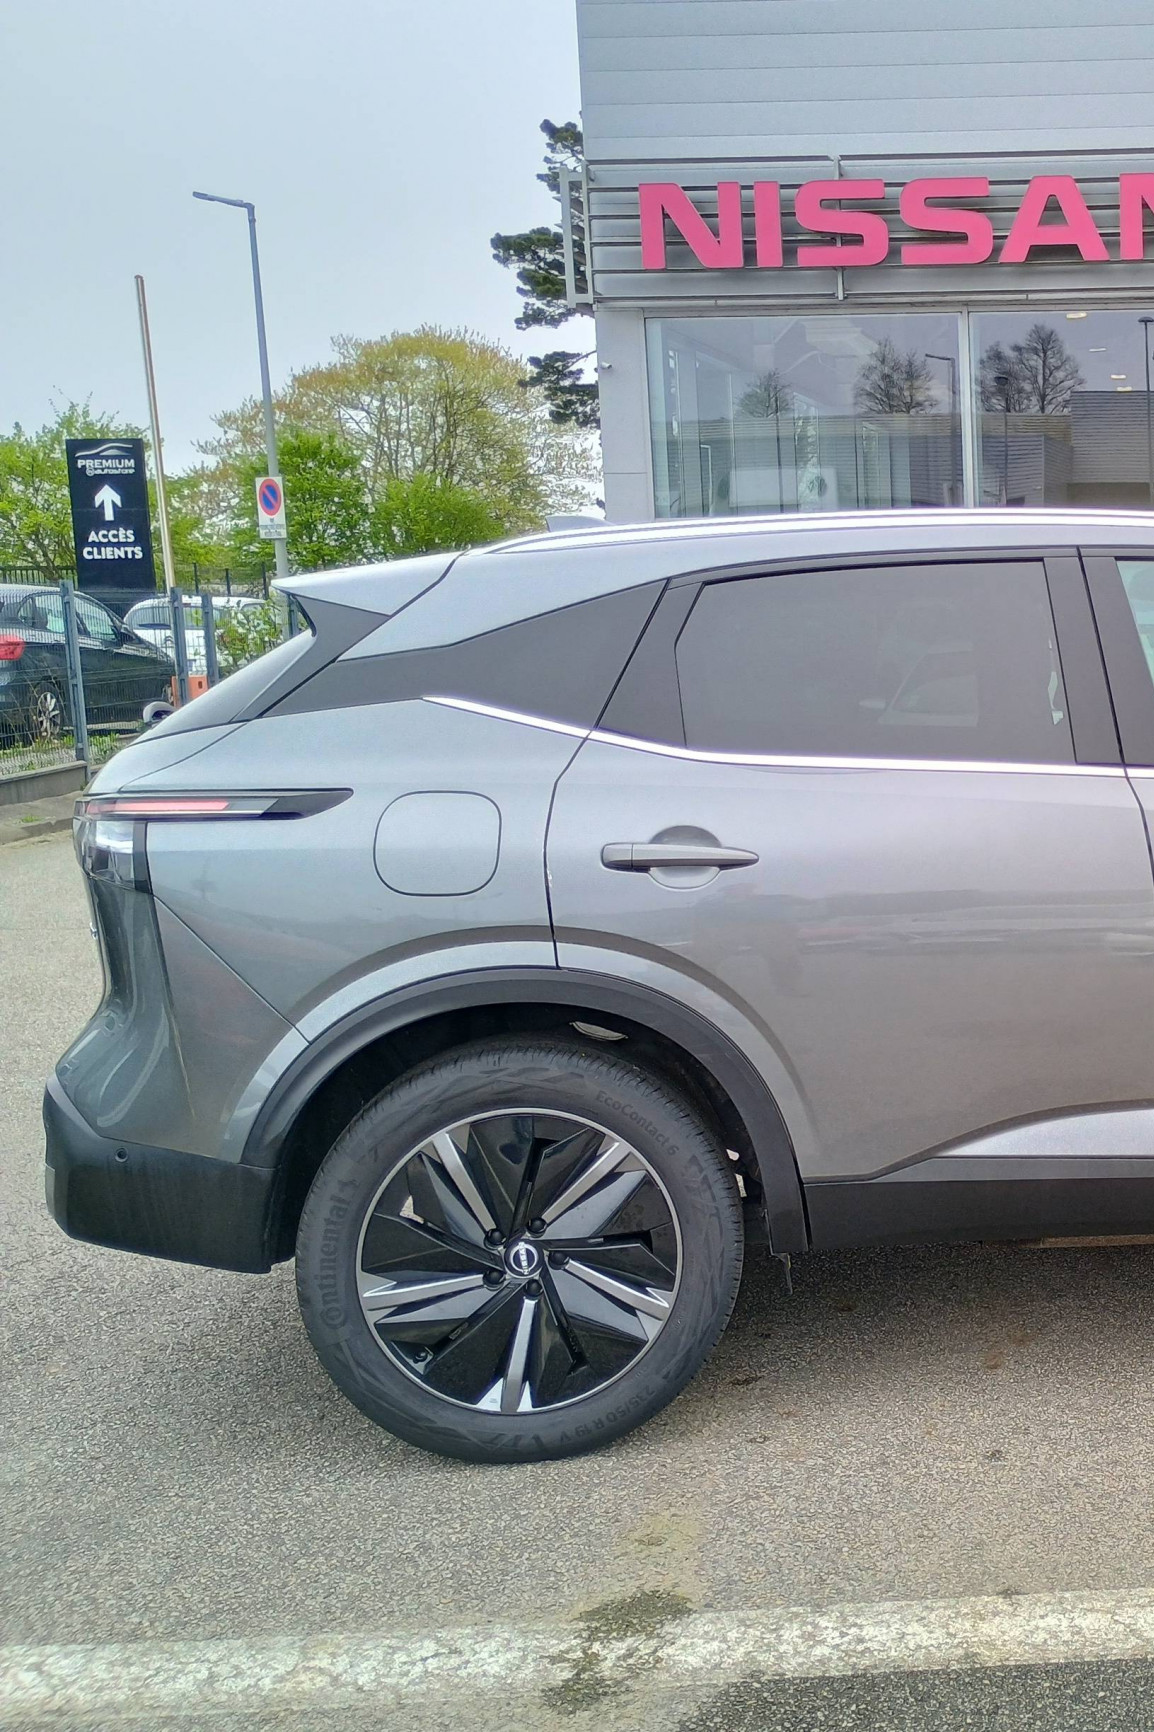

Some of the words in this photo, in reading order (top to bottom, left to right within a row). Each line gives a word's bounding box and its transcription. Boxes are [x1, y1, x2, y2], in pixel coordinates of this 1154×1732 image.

[77, 459, 135, 468] PREMIUM
[88, 528, 135, 543] ACCÈS
[82, 546, 143, 560] CLIENTS
[314, 1192, 352, 1330] Continental
